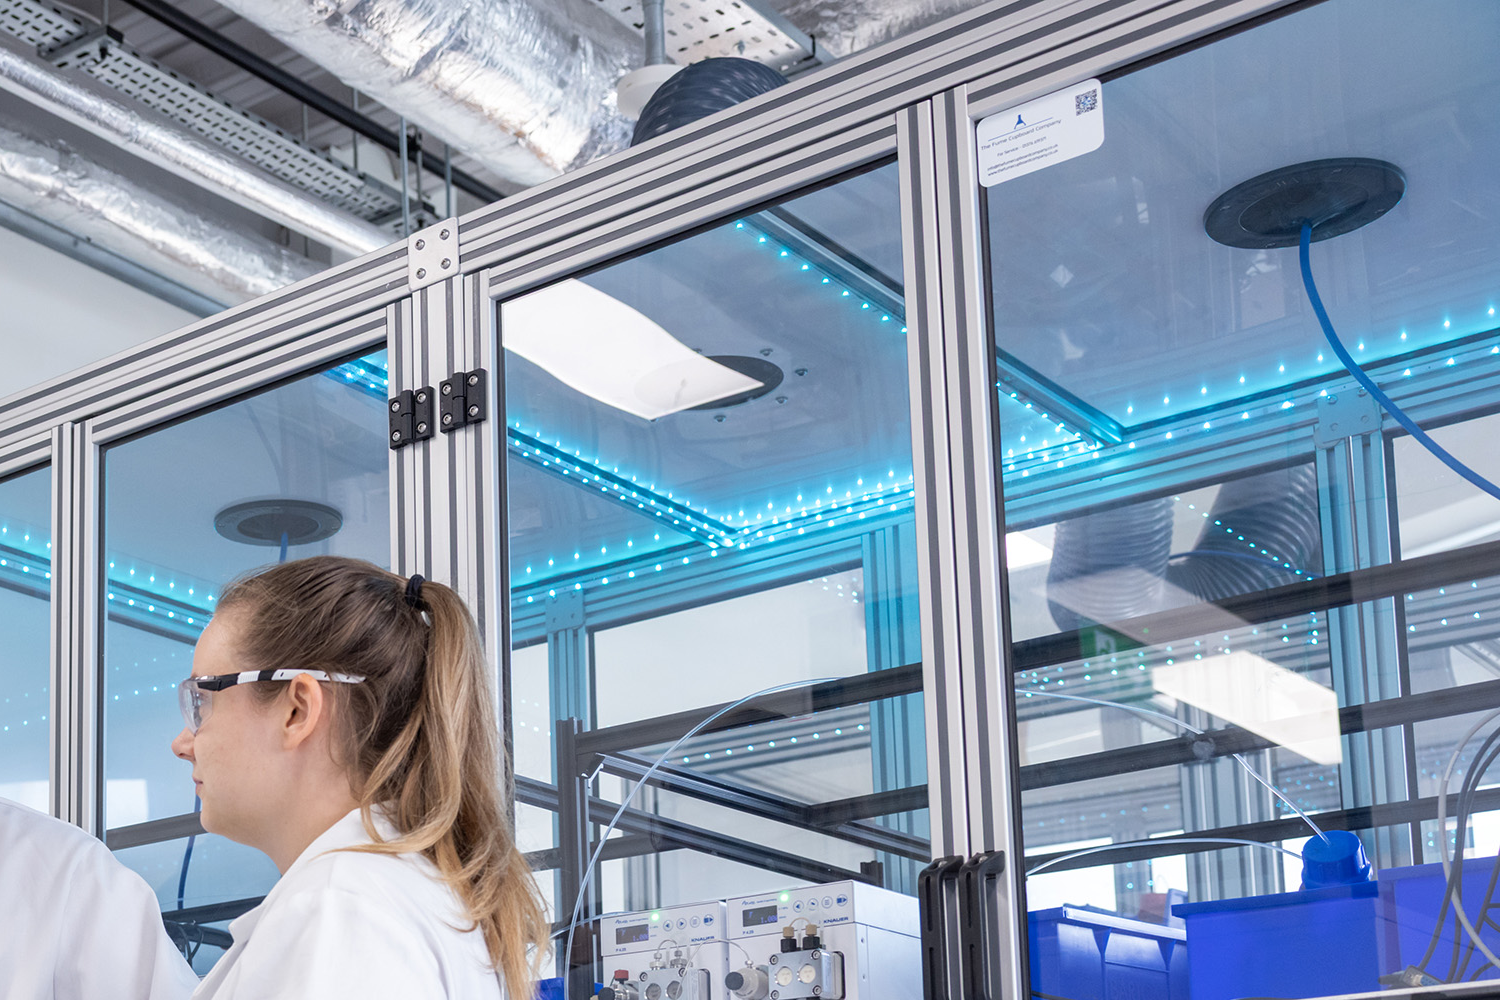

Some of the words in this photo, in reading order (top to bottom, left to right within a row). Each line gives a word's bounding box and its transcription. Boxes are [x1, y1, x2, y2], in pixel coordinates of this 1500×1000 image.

[992, 138, 1008, 147] Fume
[1035, 119, 1062, 132] Company
[823, 916, 849, 924] KNAUER
